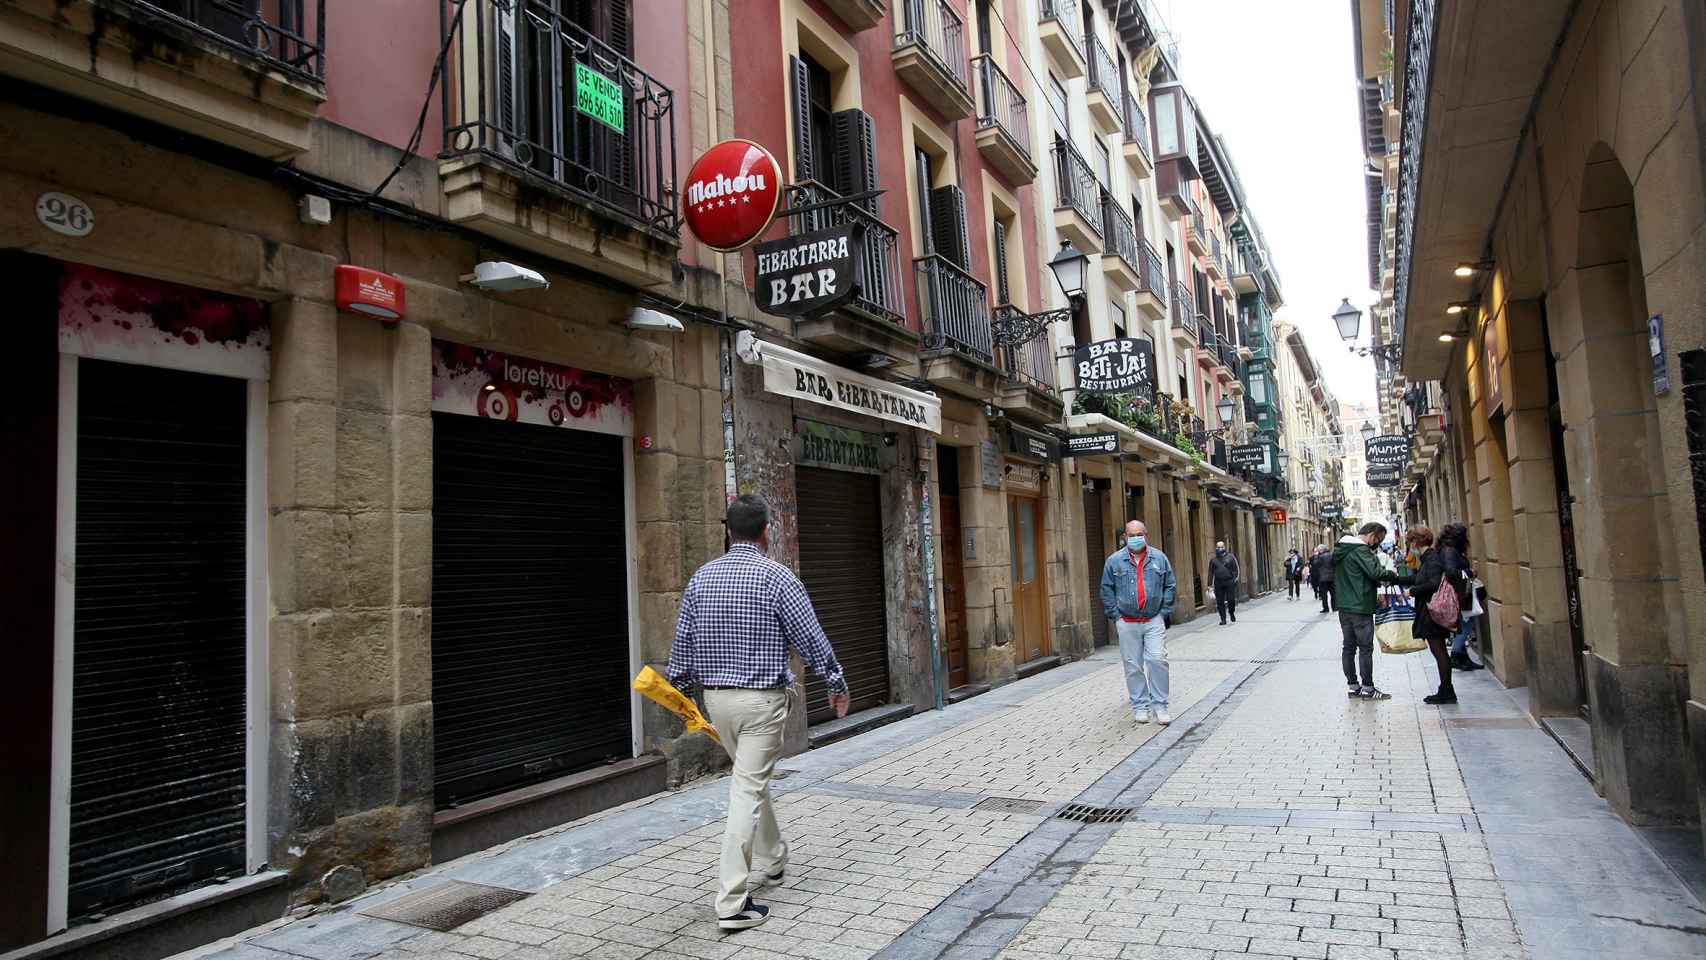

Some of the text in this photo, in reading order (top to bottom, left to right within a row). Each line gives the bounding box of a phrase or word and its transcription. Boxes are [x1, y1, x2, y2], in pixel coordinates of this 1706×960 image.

[579, 67, 622, 105] SE VENDE
[579, 90, 622, 129] 696 561 510
[688, 173, 767, 206] Mahou
[43, 198, 88, 231] 26
[769, 268, 837, 306] BAR
[1088, 340, 1133, 359] BAR
[504, 358, 567, 390] loretxu
[794, 367, 834, 402] BAR
[1080, 369, 1148, 391] RESTAURANT
